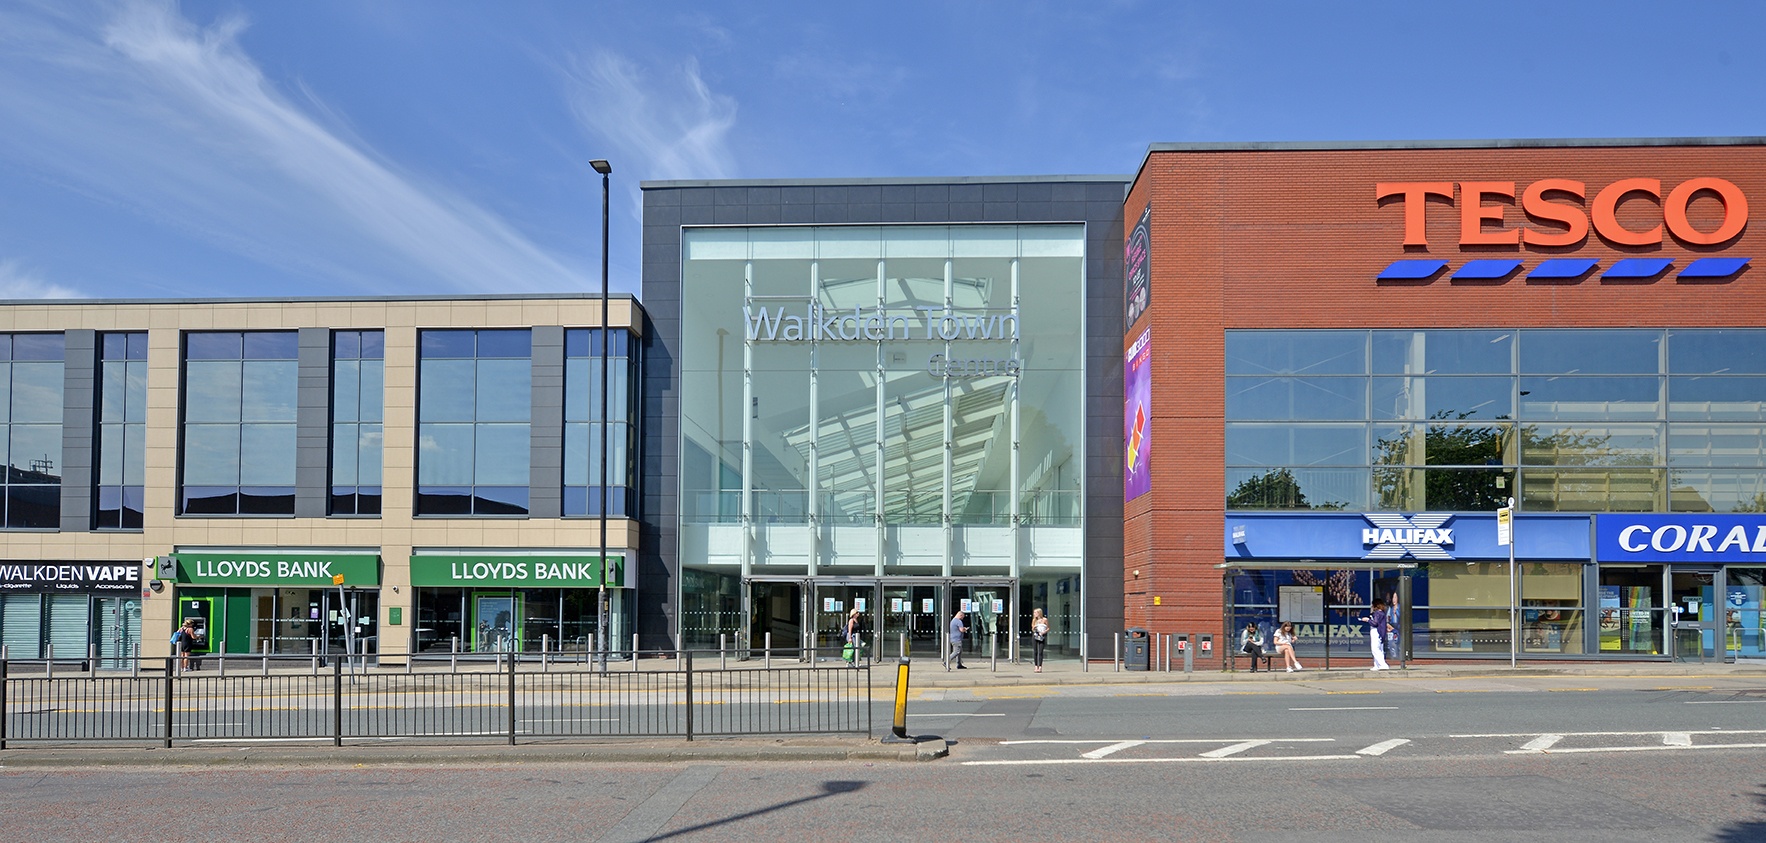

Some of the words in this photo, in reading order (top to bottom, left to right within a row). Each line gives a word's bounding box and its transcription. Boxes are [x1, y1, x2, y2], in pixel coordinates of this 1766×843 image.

[1376, 177, 1749, 246] TESCO
[742, 304, 910, 341] Walkden
[916, 304, 1021, 340] Town
[927, 353, 1021, 377] Centre
[1362, 528, 1455, 544] HALIFAX
[0, 565, 83, 581] WALKDEN
[86, 566, 138, 581] VAPE
[196, 560, 271, 578] LLOYDS
[277, 560, 333, 578] BANK
[451, 562, 528, 580] LLOYDS
[535, 563, 592, 580] BANK
